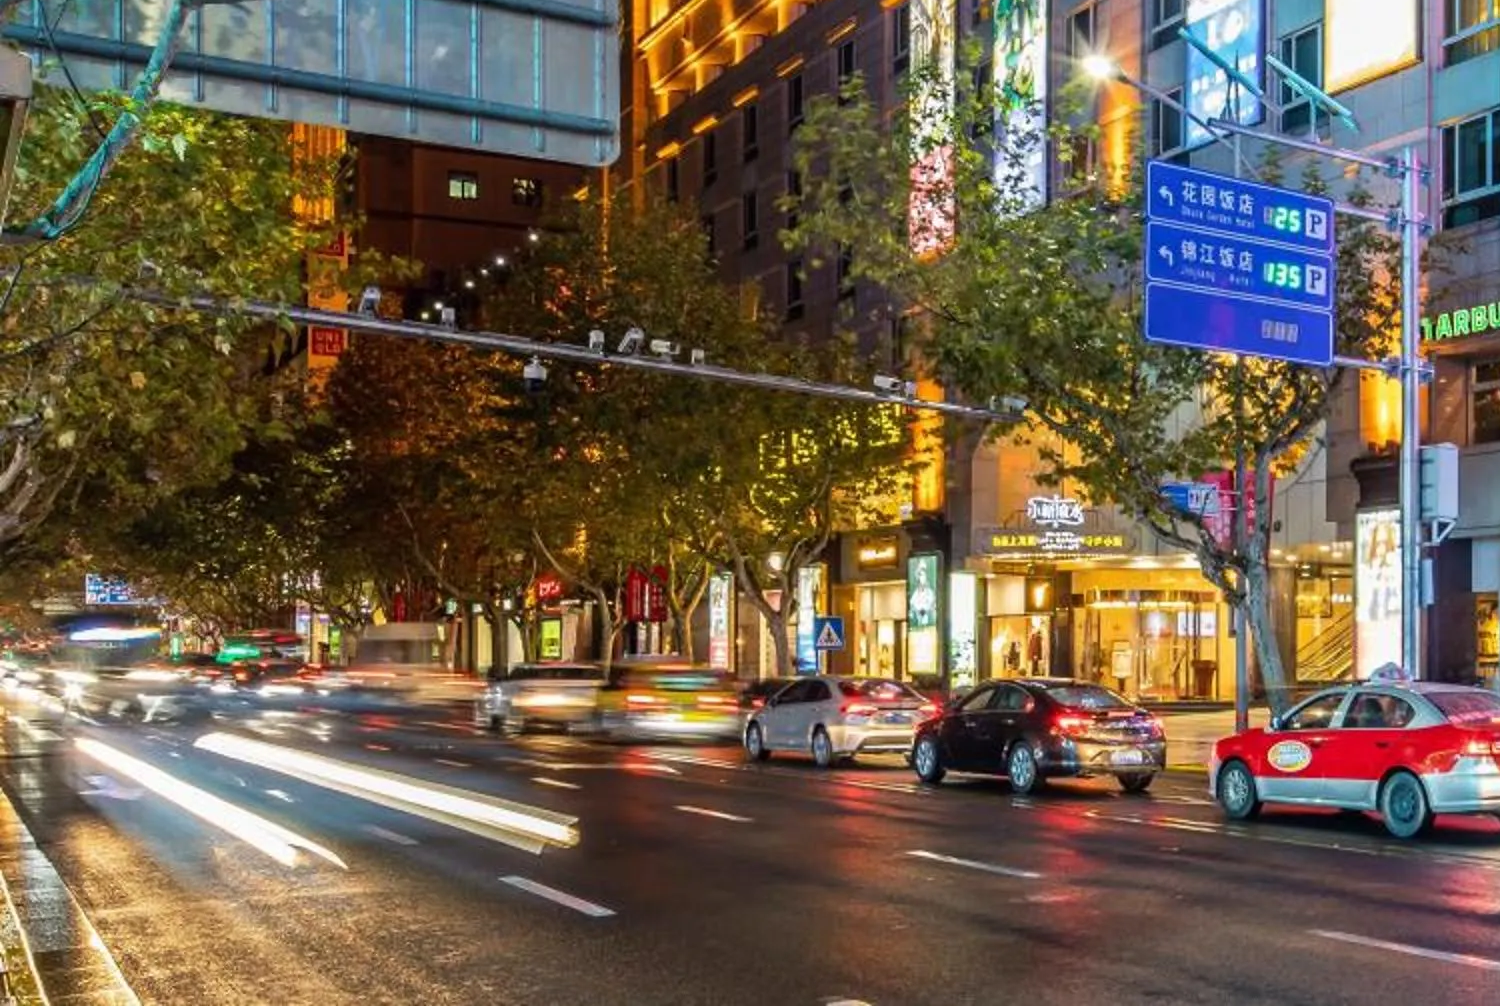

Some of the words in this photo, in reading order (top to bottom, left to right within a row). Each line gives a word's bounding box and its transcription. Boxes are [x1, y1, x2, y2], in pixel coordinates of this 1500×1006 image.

[1181, 180, 1253, 215] 花园饭店
[1309, 213, 1323, 235] P
[1181, 240, 1253, 272] 锦江饭店
[1266, 262, 1301, 290] 135
[1309, 269, 1323, 291] P
